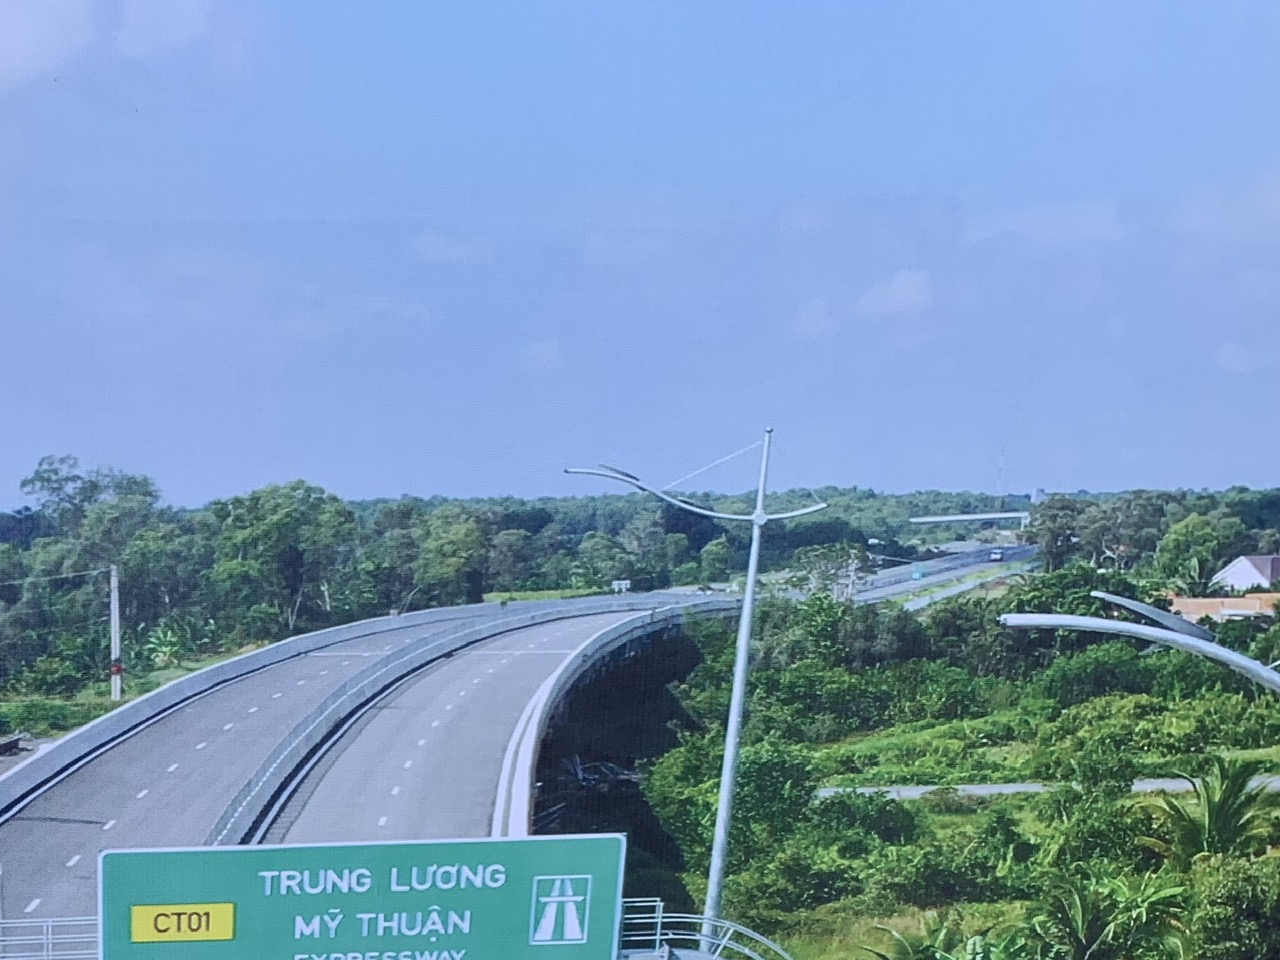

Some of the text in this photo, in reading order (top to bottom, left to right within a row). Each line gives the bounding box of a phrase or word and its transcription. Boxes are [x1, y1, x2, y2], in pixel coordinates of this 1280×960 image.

[258, 863, 507, 897] TRUNG LƯƠNG
[153, 911, 211, 934] CT01
[293, 904, 472, 944] MỸ THUẬN
